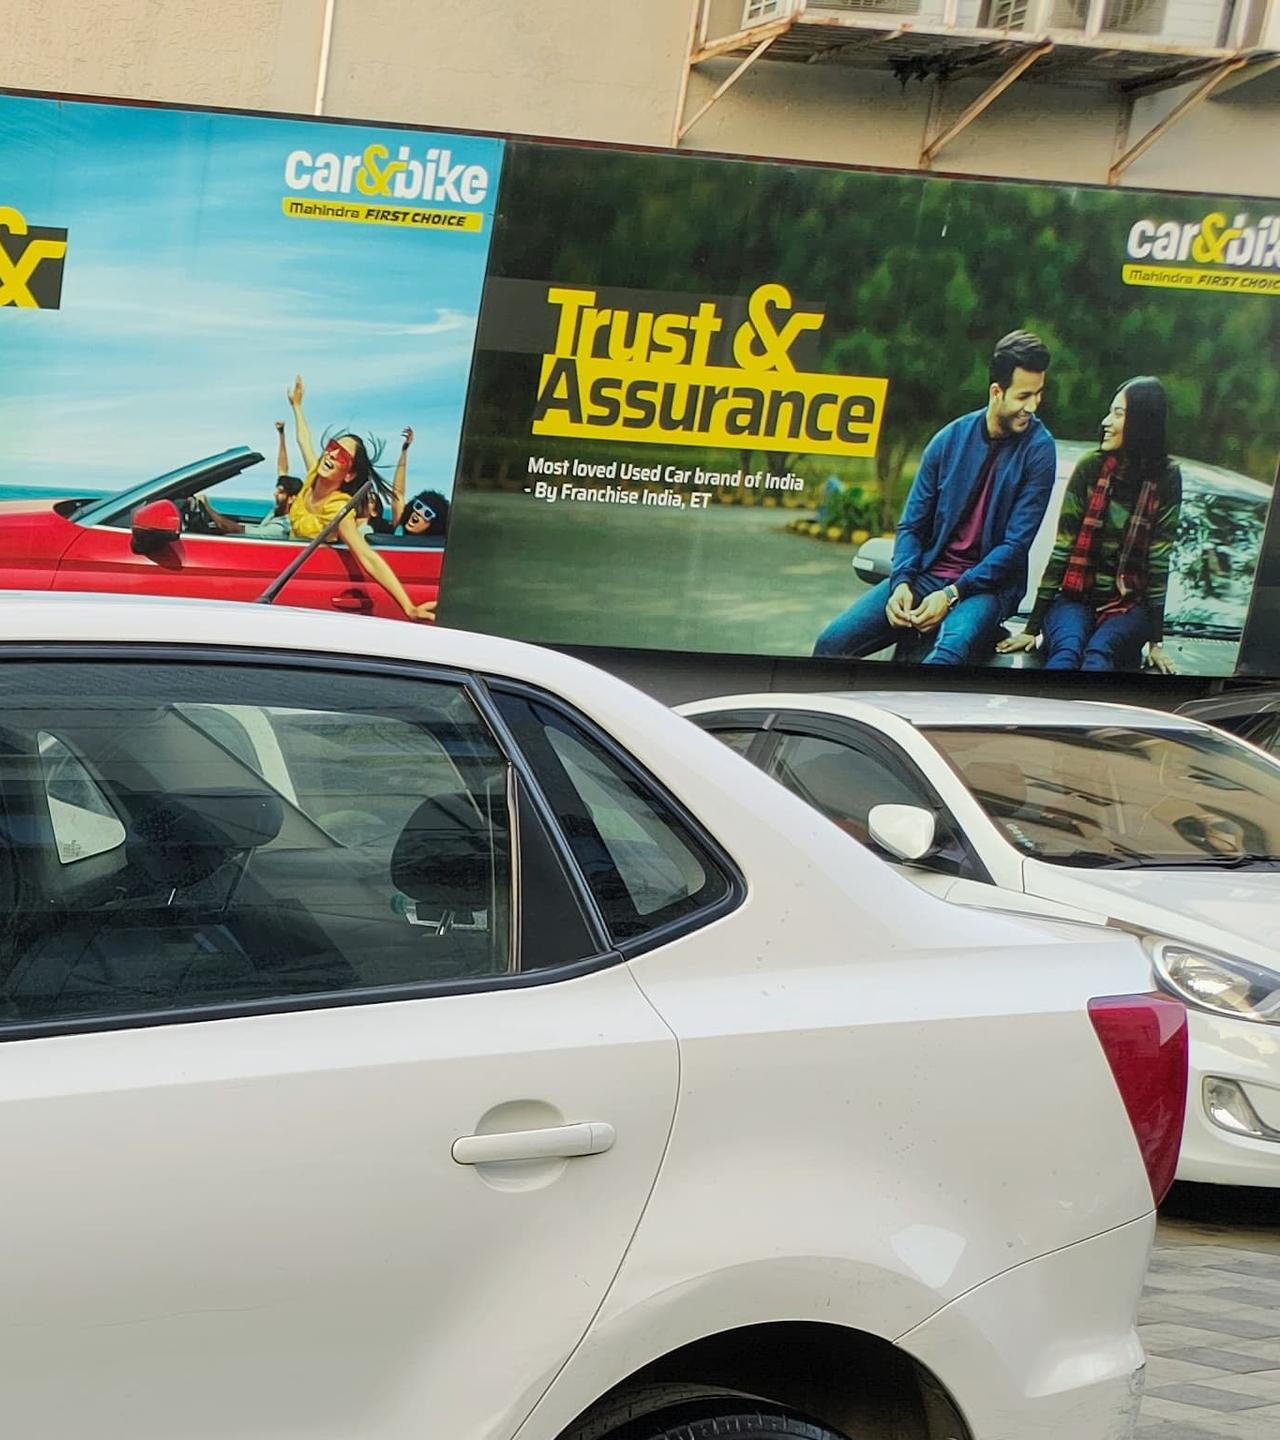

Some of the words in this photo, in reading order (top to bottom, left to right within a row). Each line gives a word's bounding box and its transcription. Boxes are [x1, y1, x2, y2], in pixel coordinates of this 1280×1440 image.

[285, 144, 488, 204] car&bike
[290, 202, 360, 219] Mahindra
[364, 209, 410, 223] FIRST
[411, 213, 467, 227] CHOICE
[1129, 269, 1193, 284] Mahindra
[1197, 275, 1238, 287] FIRST
[547, 287, 723, 367] Trust
[733, 283, 825, 374] &
[531, 358, 876, 444] Assurance
[527, 456, 570, 476] Most
[572, 459, 617, 479] loved
[620, 463, 662, 482] Used
[664, 466, 692, 484] Car
[694, 467, 743, 487] brand
[744, 471, 763, 489] of
[765, 472, 805, 491] India
[534, 482, 558, 503] By
[561, 483, 639, 505] Franchise
[642, 489, 686, 510] India,
[690, 491, 713, 509] ET
